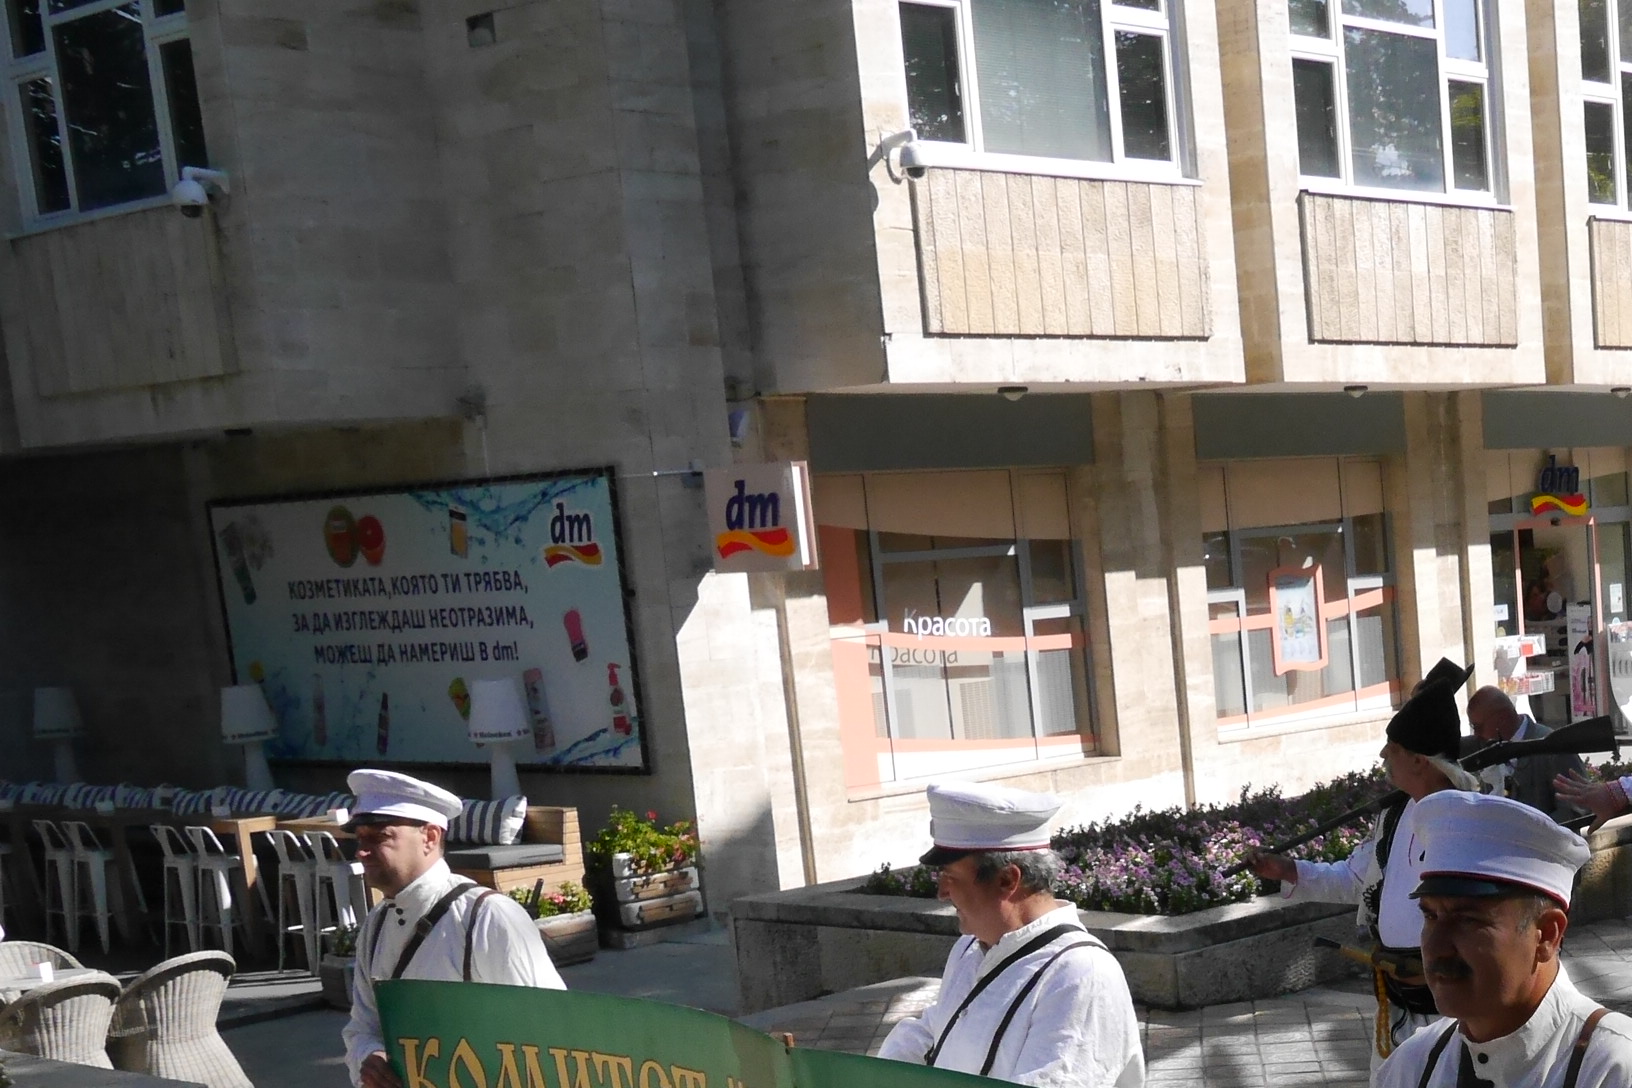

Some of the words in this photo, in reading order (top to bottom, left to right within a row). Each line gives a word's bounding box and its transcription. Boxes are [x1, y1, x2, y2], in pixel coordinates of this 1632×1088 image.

[1540, 454, 1579, 494] dm
[726, 480, 781, 531] dm
[551, 502, 592, 544] dm
[441, 573, 462, 594] ТИ
[464, 570, 528, 594] ТРЯБВА,
[292, 613, 310, 632] ЗА
[313, 611, 332, 635] ДА
[333, 609, 425, 634] ИЗГЛЕЖДАШ
[429, 605, 534, 629] НЕОТРАЗИМА,
[903, 607, 991, 640] Красота
[314, 644, 373, 664] МОЖЕШ
[377, 643, 396, 667] ДА
[399, 641, 475, 663] НАМЕРИШ
[479, 641, 489, 661] В
[492, 640, 519, 661] dm!
